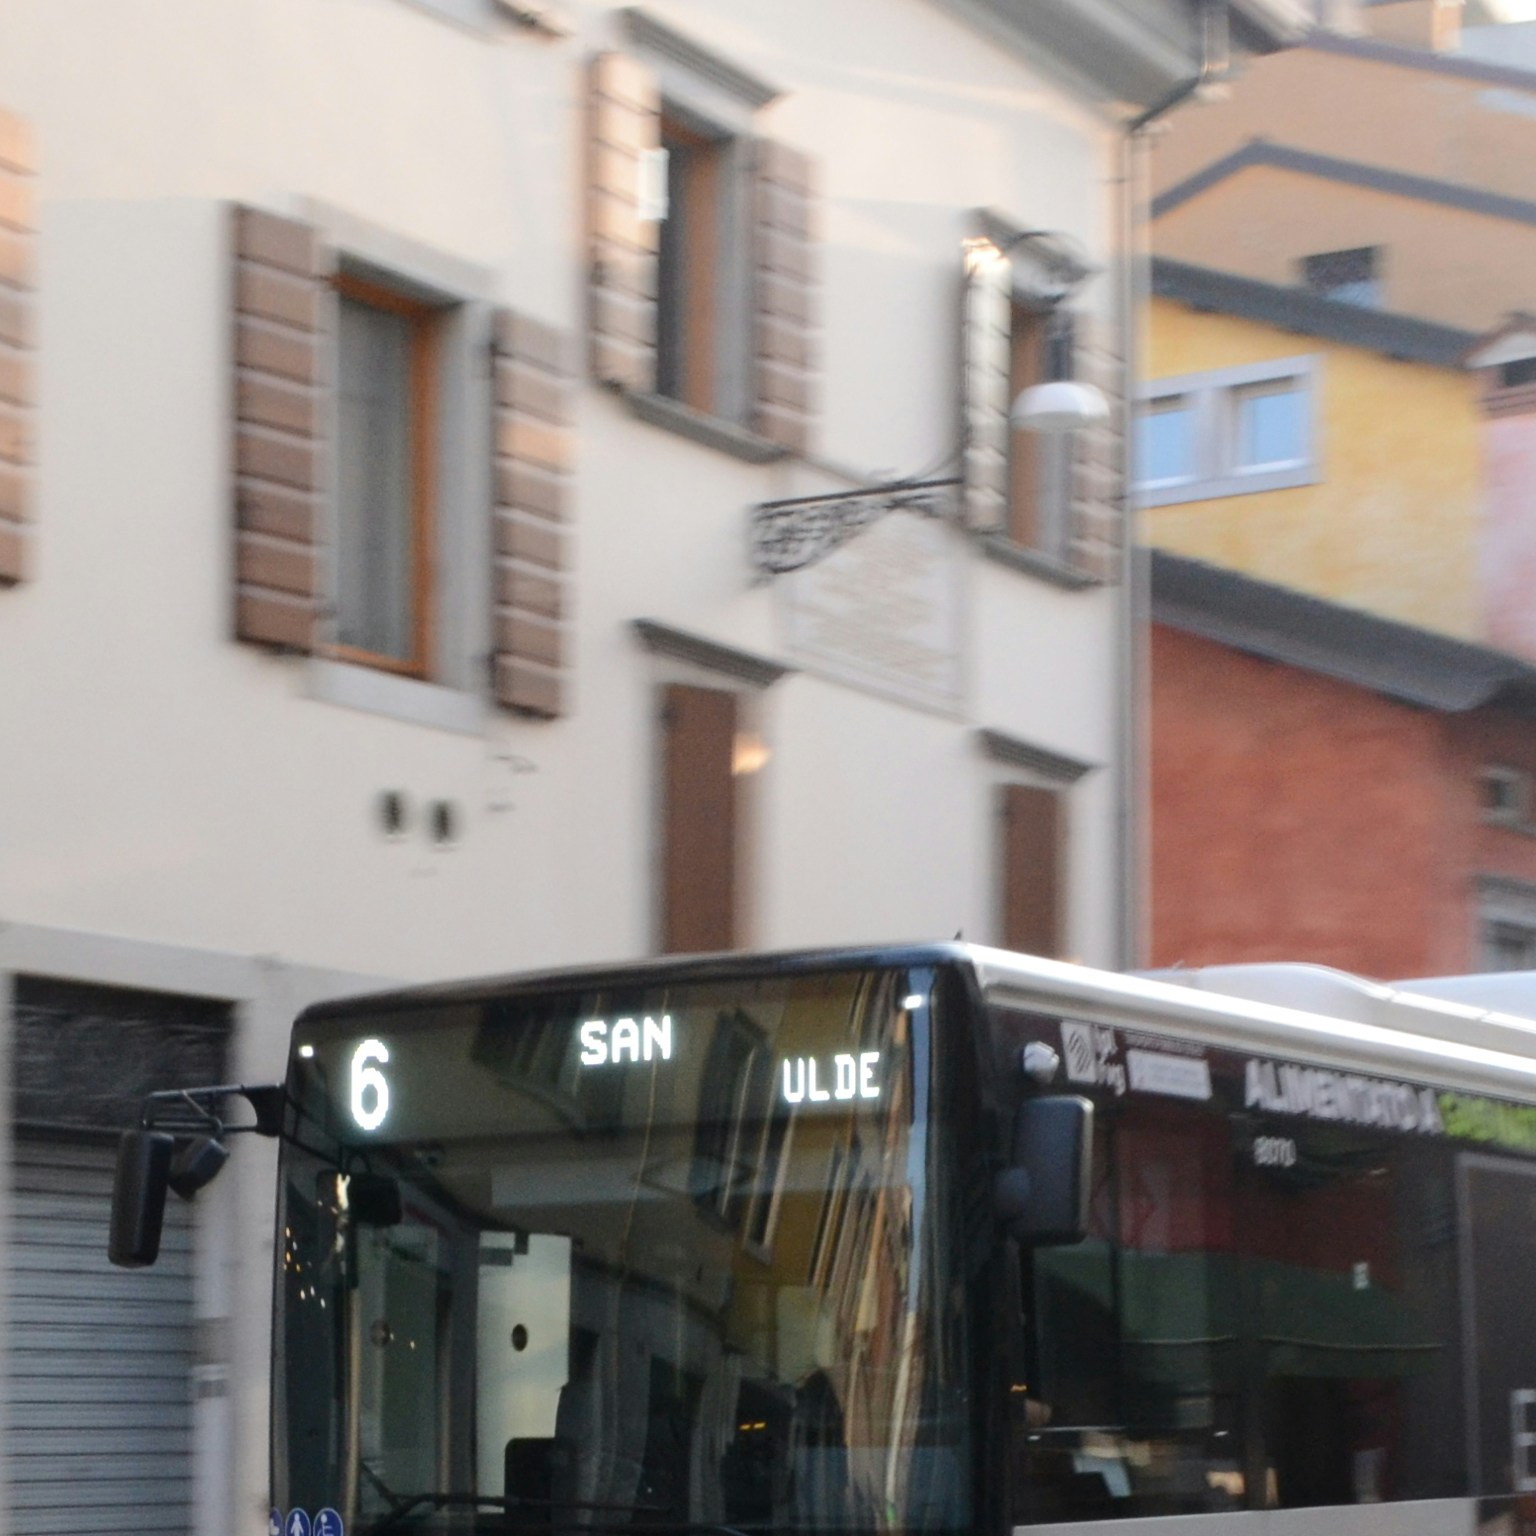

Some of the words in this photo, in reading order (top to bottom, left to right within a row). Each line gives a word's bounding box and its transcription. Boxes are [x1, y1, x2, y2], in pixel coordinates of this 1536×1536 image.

[580, 1015, 673, 1066] SAN
[349, 1038, 390, 1132] 6
[782, 1050, 881, 1104] ULDE
